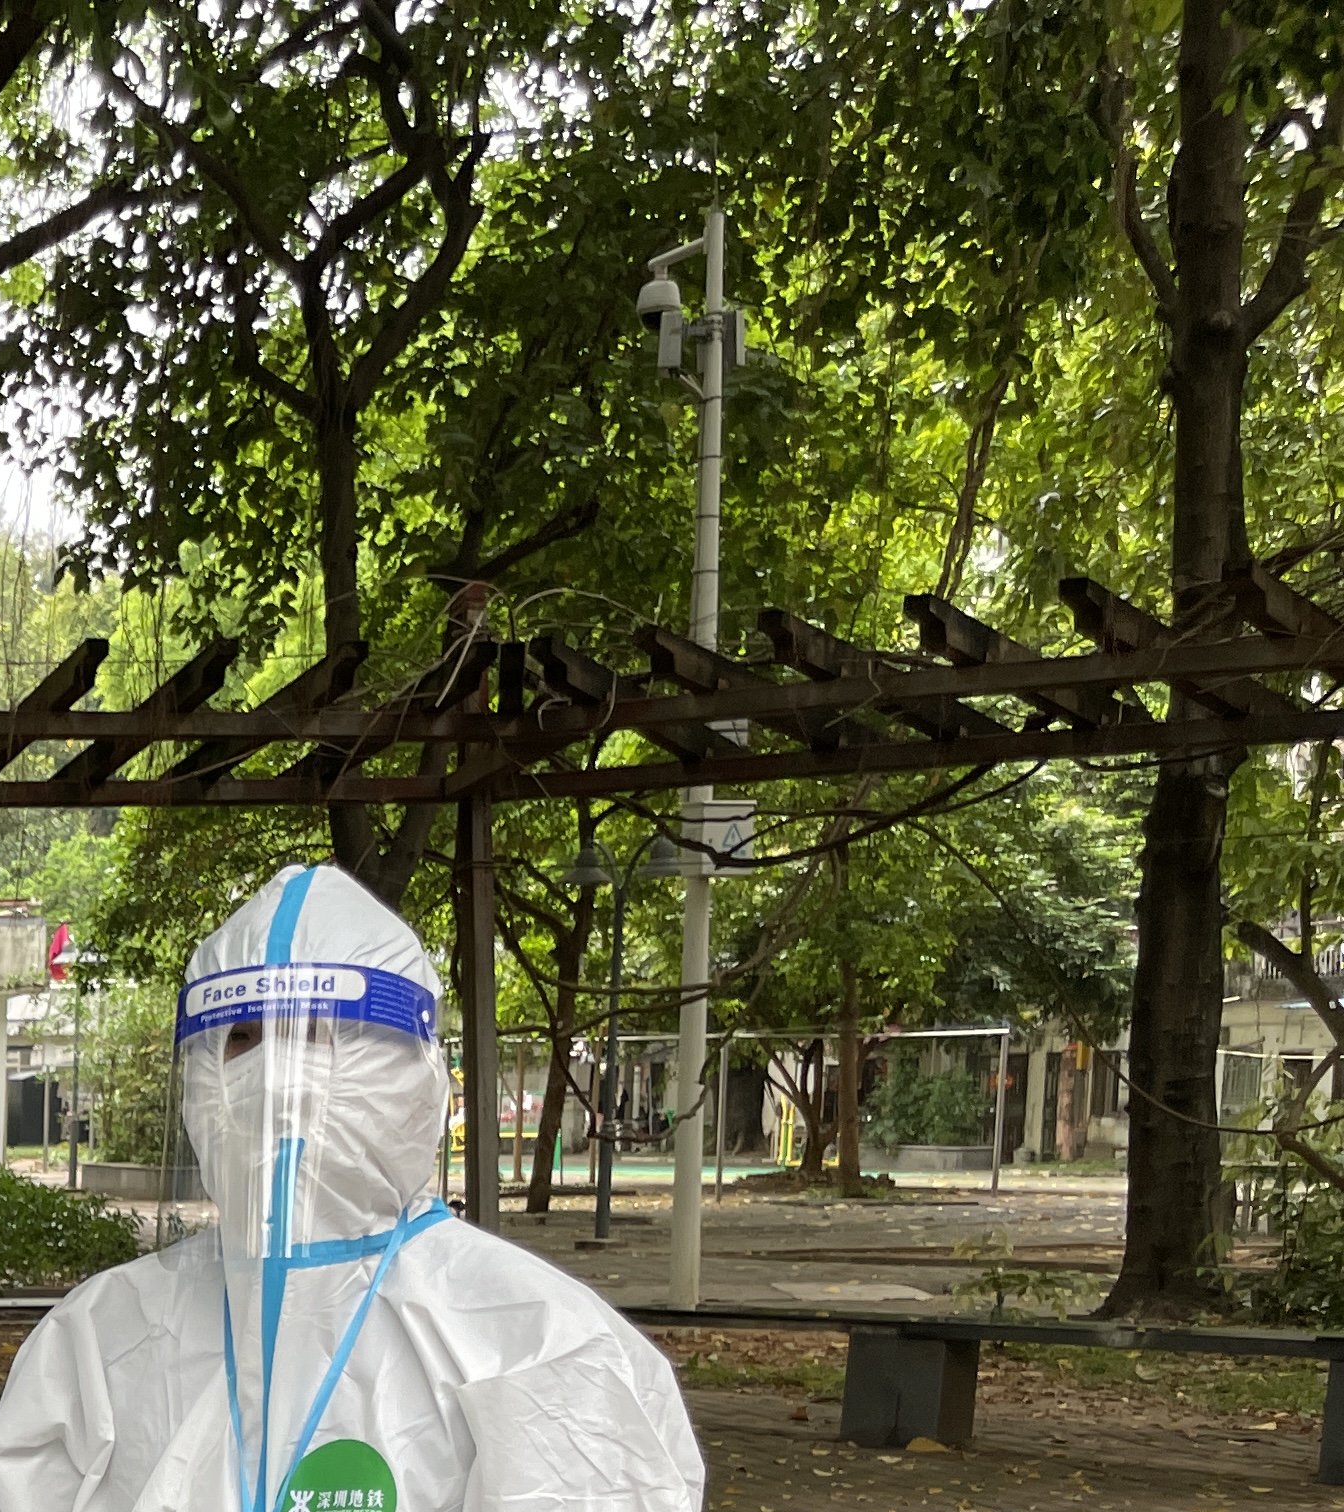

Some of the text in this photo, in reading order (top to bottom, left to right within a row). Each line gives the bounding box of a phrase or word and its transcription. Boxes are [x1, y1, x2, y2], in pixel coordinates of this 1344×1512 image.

[202, 975, 336, 1006] Face Shield
[317, 1489, 385, 1509] 深圳地铁
